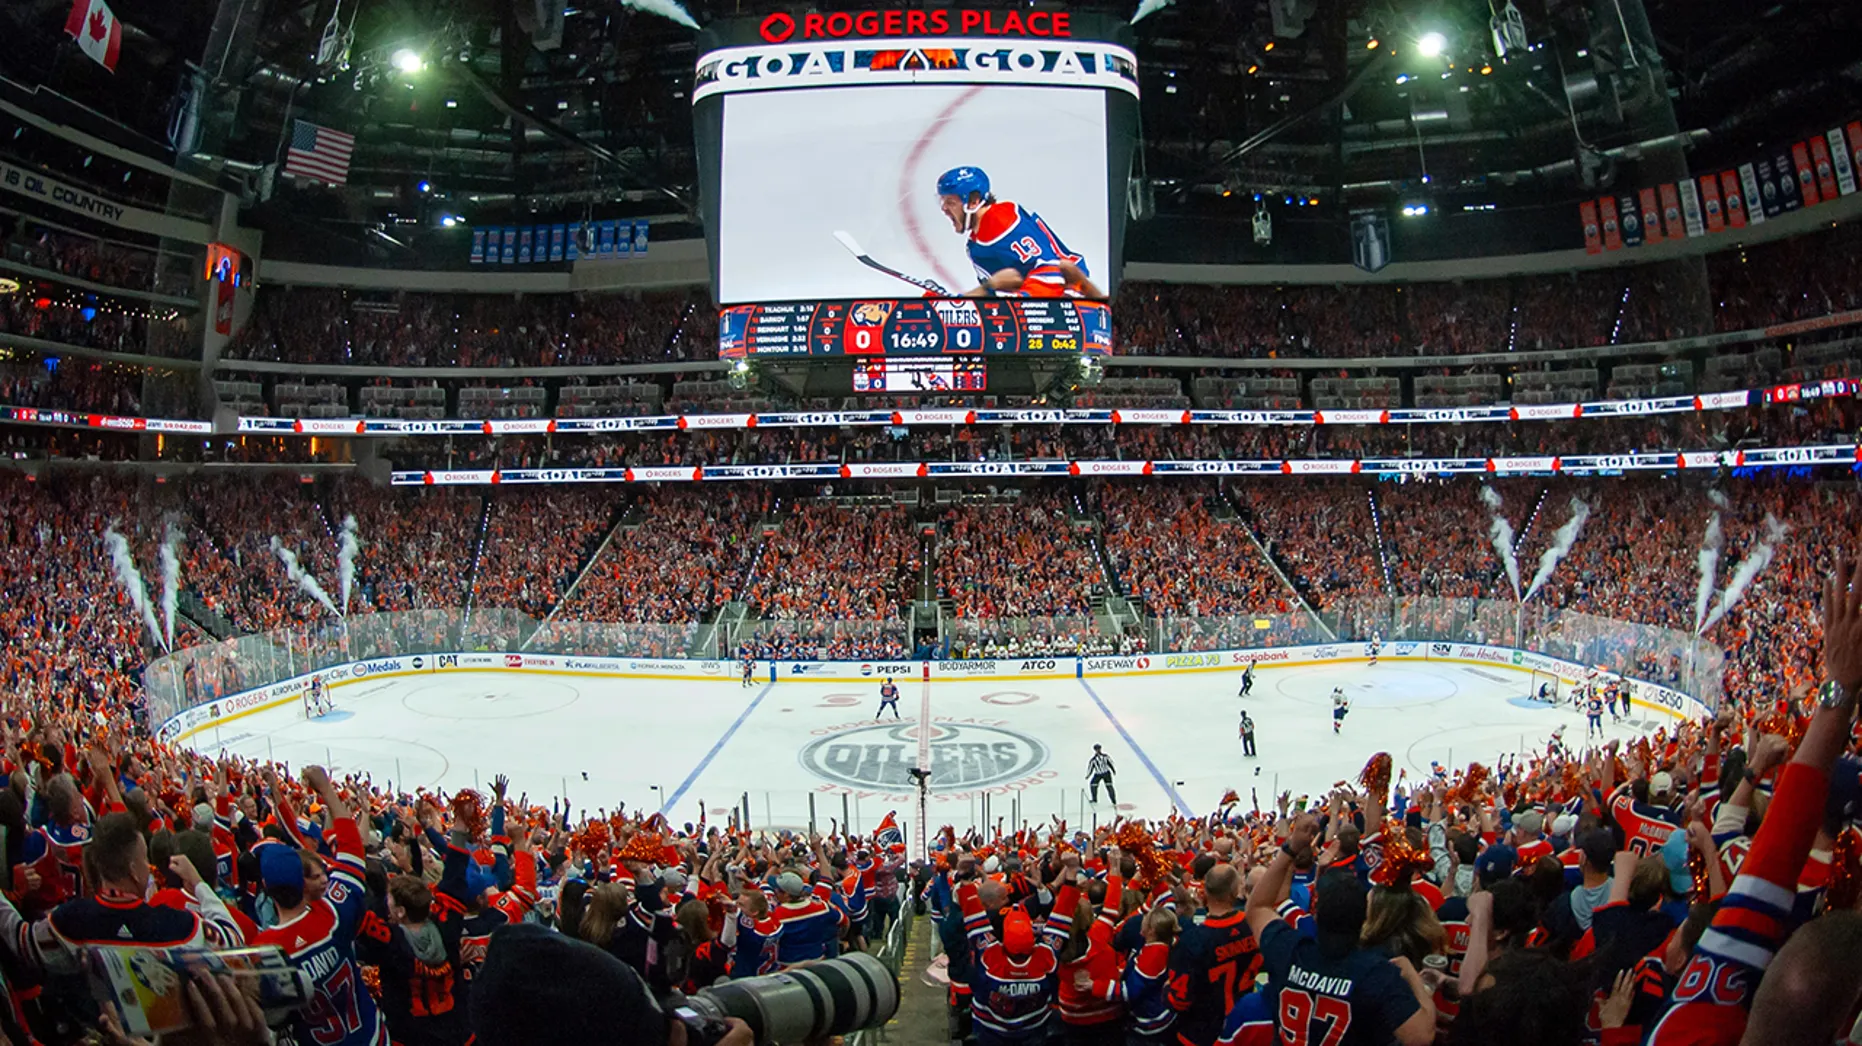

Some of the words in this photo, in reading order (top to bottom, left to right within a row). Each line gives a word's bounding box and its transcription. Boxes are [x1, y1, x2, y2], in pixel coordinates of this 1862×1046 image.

[804, 9, 950, 37] ROGERS
[961, 10, 1072, 37] PLACE
[718, 49, 871, 79] GOAL
[4, 167, 20, 187] IS
[24, 177, 48, 197] OIL
[52, 186, 124, 221] COUNTRY
[1009, 236, 1043, 264] 13
[828, 310, 836, 318] 0
[823, 327, 831, 335] 0
[856, 330, 871, 349] 0
[891, 332, 939, 348] 16:49
[956, 329, 971, 348] 0
[1028, 338, 1043, 349] 25
[1051, 338, 1077, 349] 0:42
[823, 344, 831, 352] 0
[996, 341, 1004, 350] 0
[1616, 401, 1664, 414] GOAL
[706, 417, 735, 425] ROGERS
[924, 413, 953, 421] ROGERS
[510, 422, 537, 430] ROGERS
[1776, 448, 1821, 461] GOAL
[1102, 464, 1131, 472] ROGERS
[1311, 463, 1339, 471] ROGERS
[1514, 460, 1541, 468] ROGERS
[1596, 456, 1642, 468] GOAL
[654, 470, 682, 478] ROGERS
[872, 466, 903, 474] ROGERS
[452, 474, 480, 482] ROGERS
[1312, 647, 1339, 659] Ford
[1432, 643, 1452, 653] SN
[1459, 645, 1475, 658] Tim
[1476, 647, 1509, 663] Hortons
[438, 654, 459, 668] CAT
[1166, 656, 1204, 668] PIZZA
[1205, 654, 1221, 666] 73
[1232, 651, 1289, 663] Scotiabank
[367, 660, 402, 674] Medals
[700, 661, 720, 669] aws
[876, 665, 912, 674] PEPSI
[938, 661, 996, 671] BODYARMOR
[1020, 660, 1056, 670] ATCO
[1087, 657, 1136, 670] SAFEWAY
[330, 669, 348, 680] Clips
[236, 691, 268, 709] ROGERS
[823, 716, 916, 733] ROGERS
[934, 716, 1010, 727] PLACE
[823, 741, 1020, 787] OILERS
[1288, 964, 1352, 996] McDAVID
[998, 982, 1041, 997] McDAVID
[298, 957, 362, 1046] 97
[1279, 987, 1352, 1046] 97
